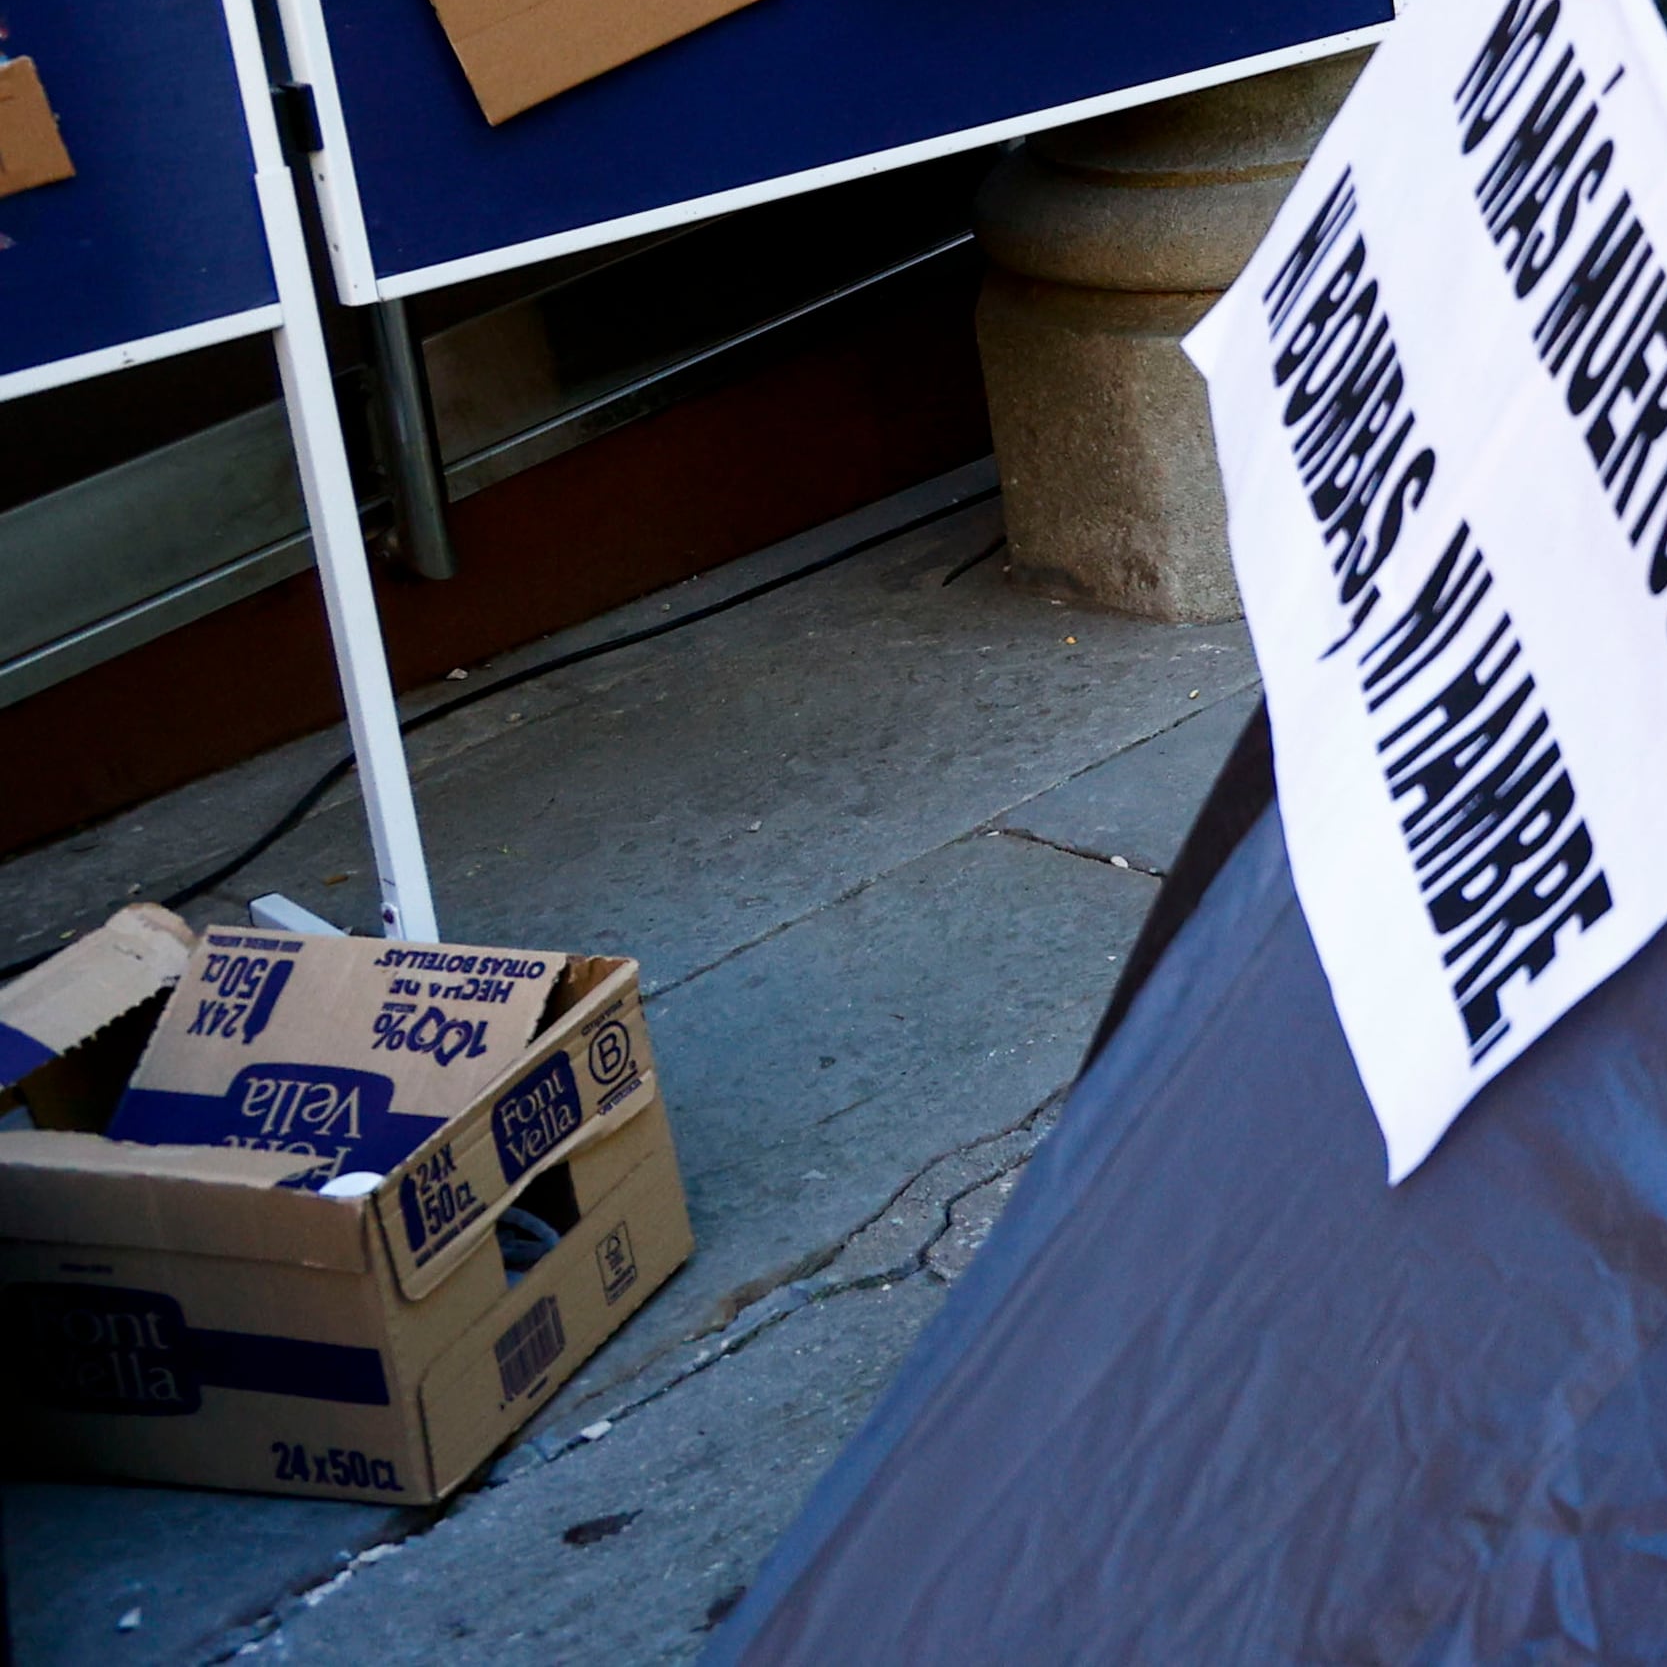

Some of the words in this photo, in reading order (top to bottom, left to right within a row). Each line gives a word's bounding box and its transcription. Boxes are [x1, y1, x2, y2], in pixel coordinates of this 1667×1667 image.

[1473, 41, 1627, 301] MÁS
[1261, 162, 1359, 344] NI
[1273, 230, 1438, 663] BOMBAS,
[1356, 516, 1494, 715] NI
[475, 954, 547, 981] OTRAS
[240, 1075, 363, 1140] Vella
[500, 1069, 567, 1138] Font
[505, 1102, 578, 1170] Vella
